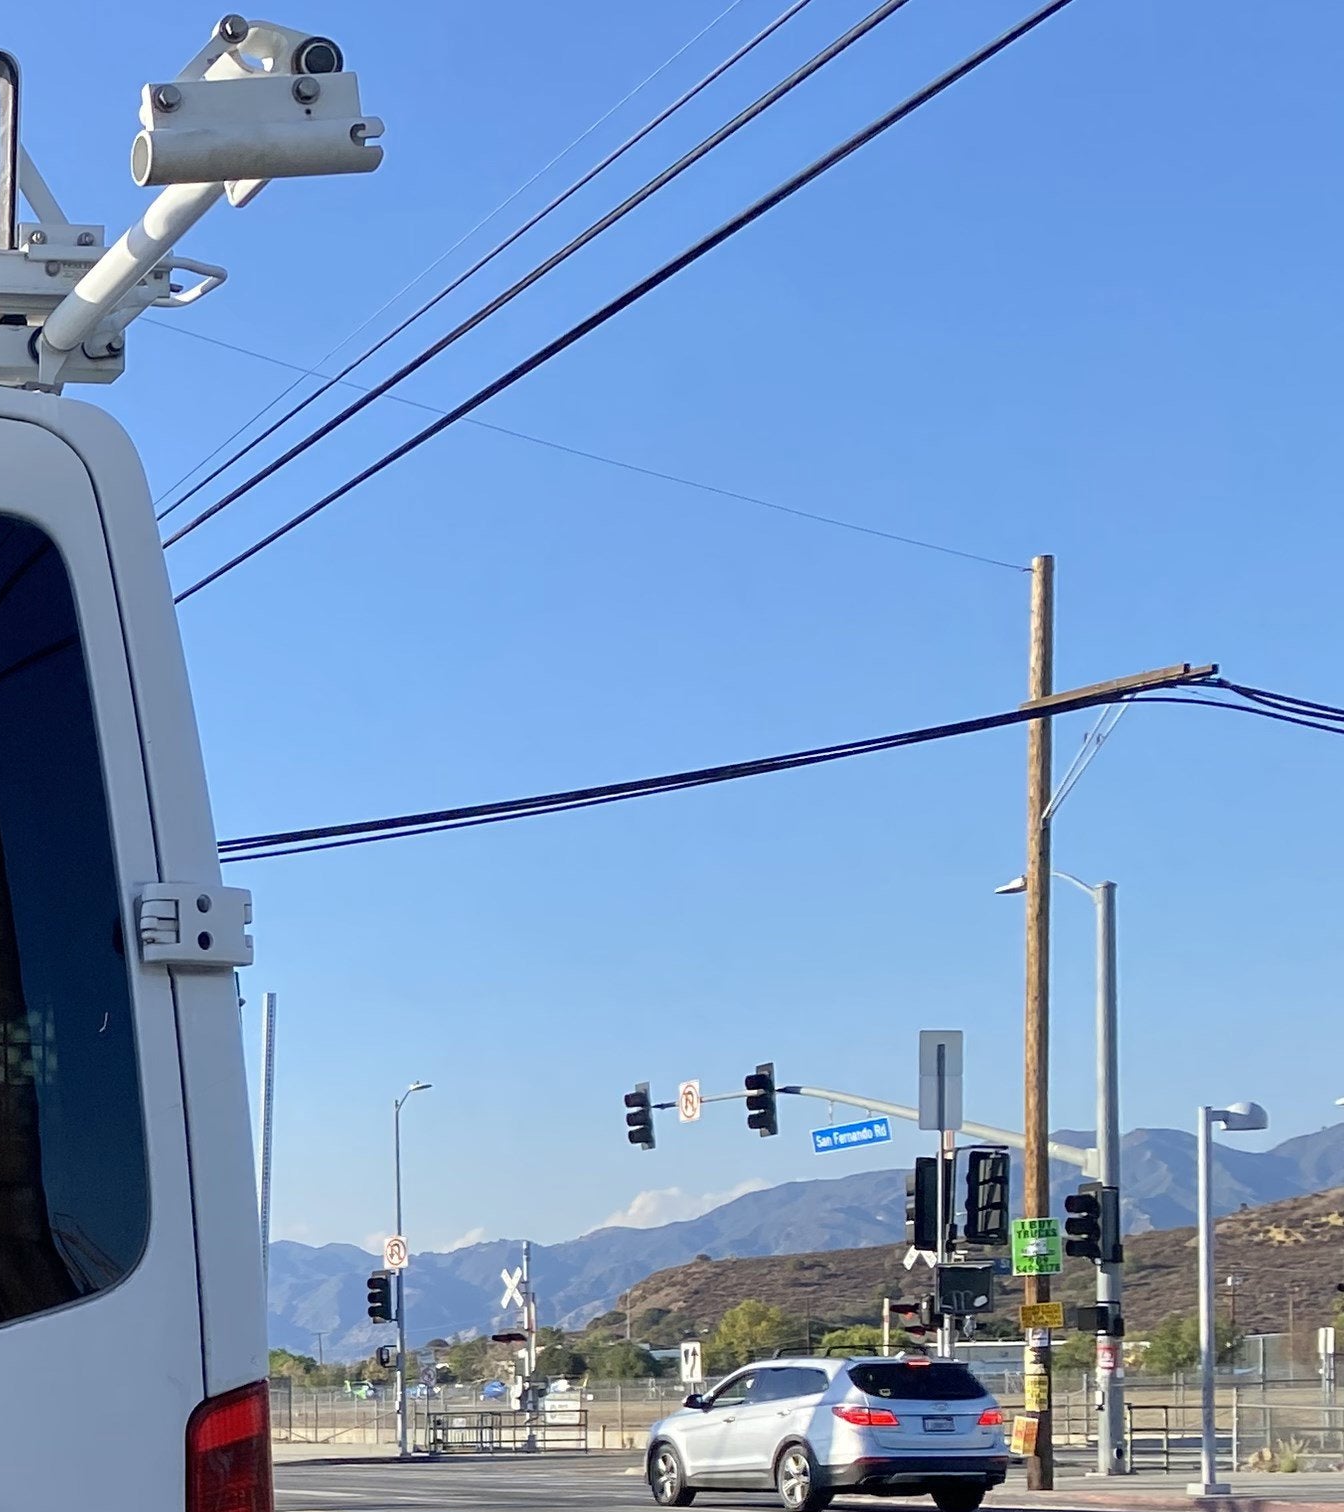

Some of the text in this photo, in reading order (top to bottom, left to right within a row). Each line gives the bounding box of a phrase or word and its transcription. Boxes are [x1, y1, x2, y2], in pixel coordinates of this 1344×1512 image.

[815, 1123, 887, 1148] San Fernando Rd
[1029, 1220, 1052, 1229] BUY
[1016, 1229, 1058, 1239] TRUCKS
